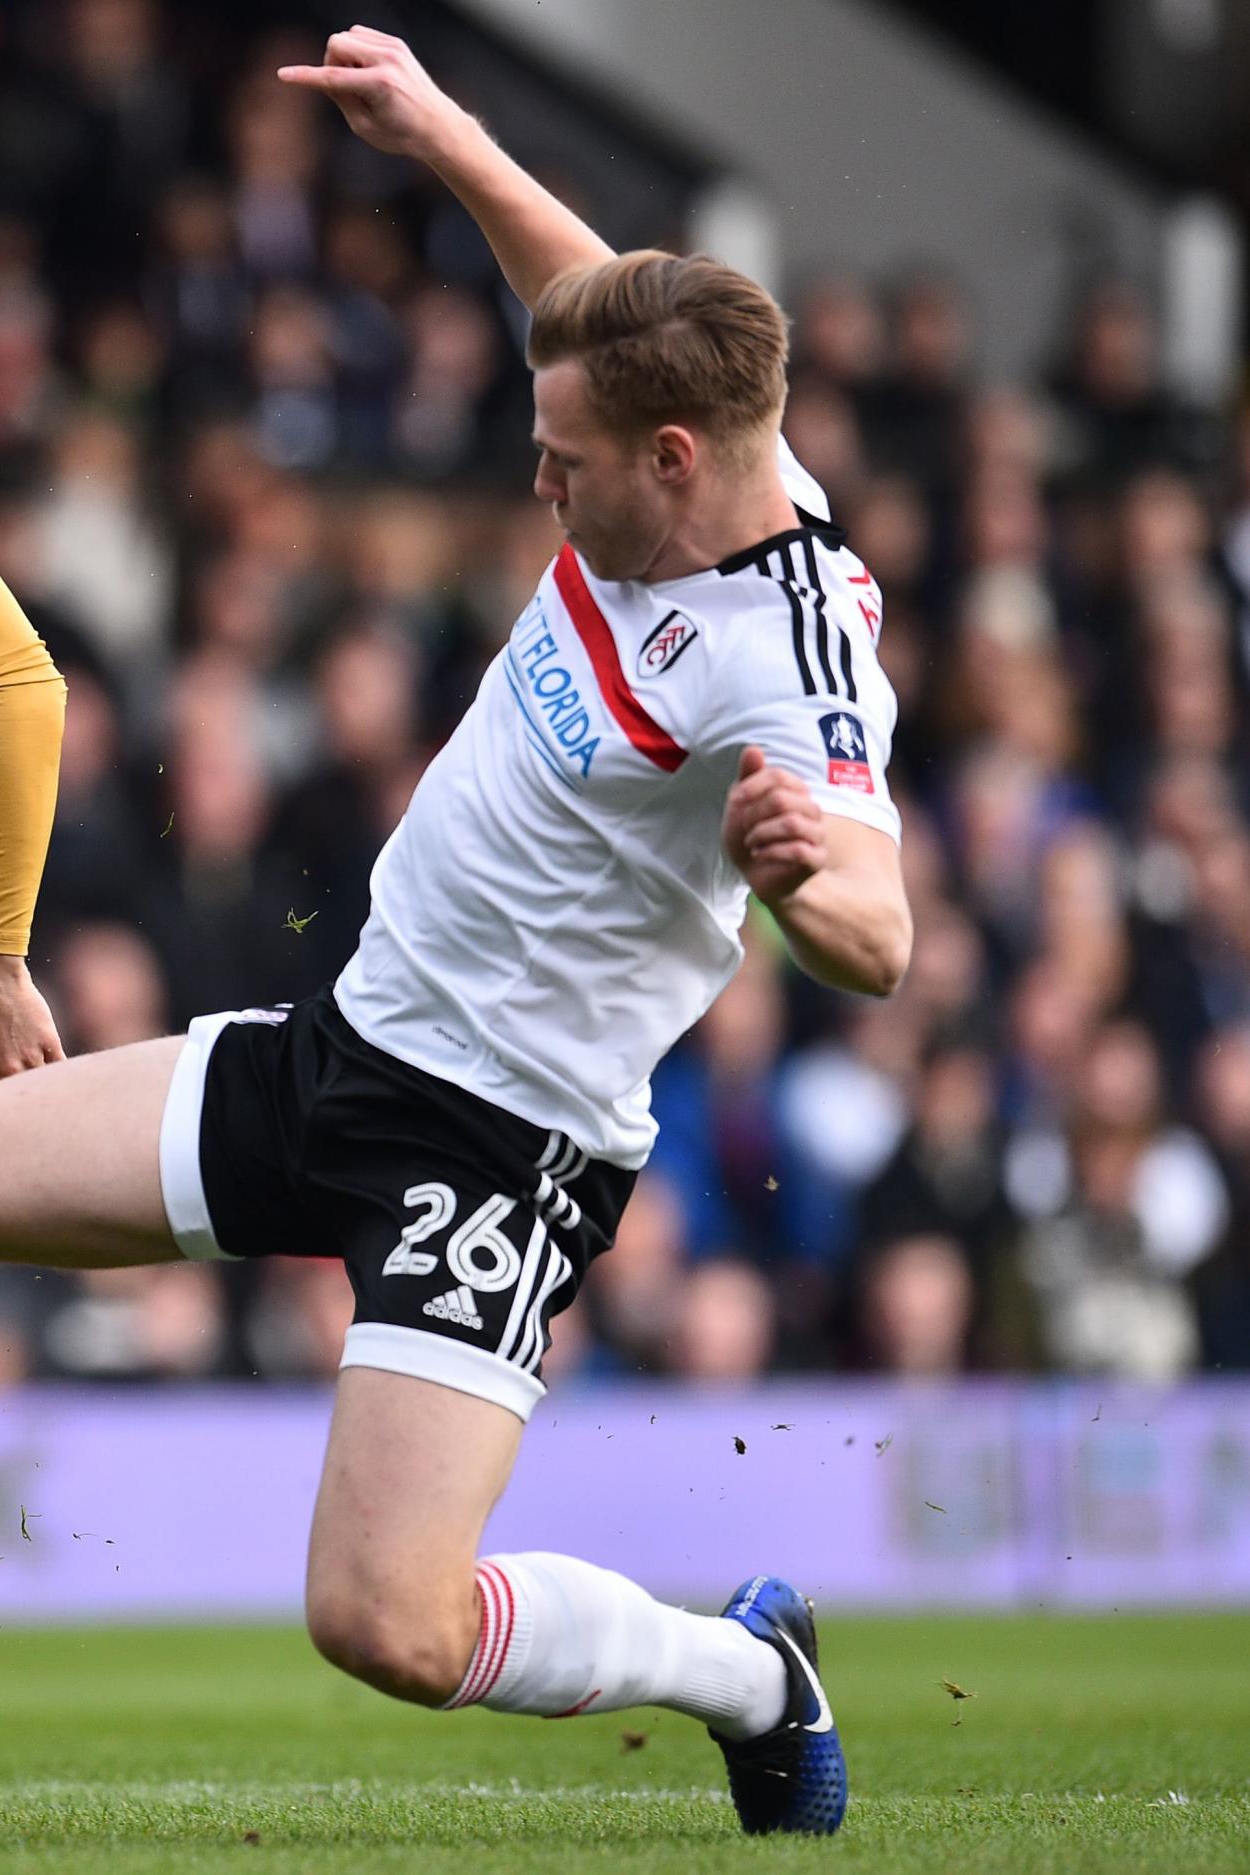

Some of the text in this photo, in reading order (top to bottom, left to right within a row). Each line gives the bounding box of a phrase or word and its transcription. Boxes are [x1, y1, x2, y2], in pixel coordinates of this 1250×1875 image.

[646, 625, 687, 667] FFC
[381, 1181, 522, 1293] 26
[422, 1301, 485, 1331] adidas
